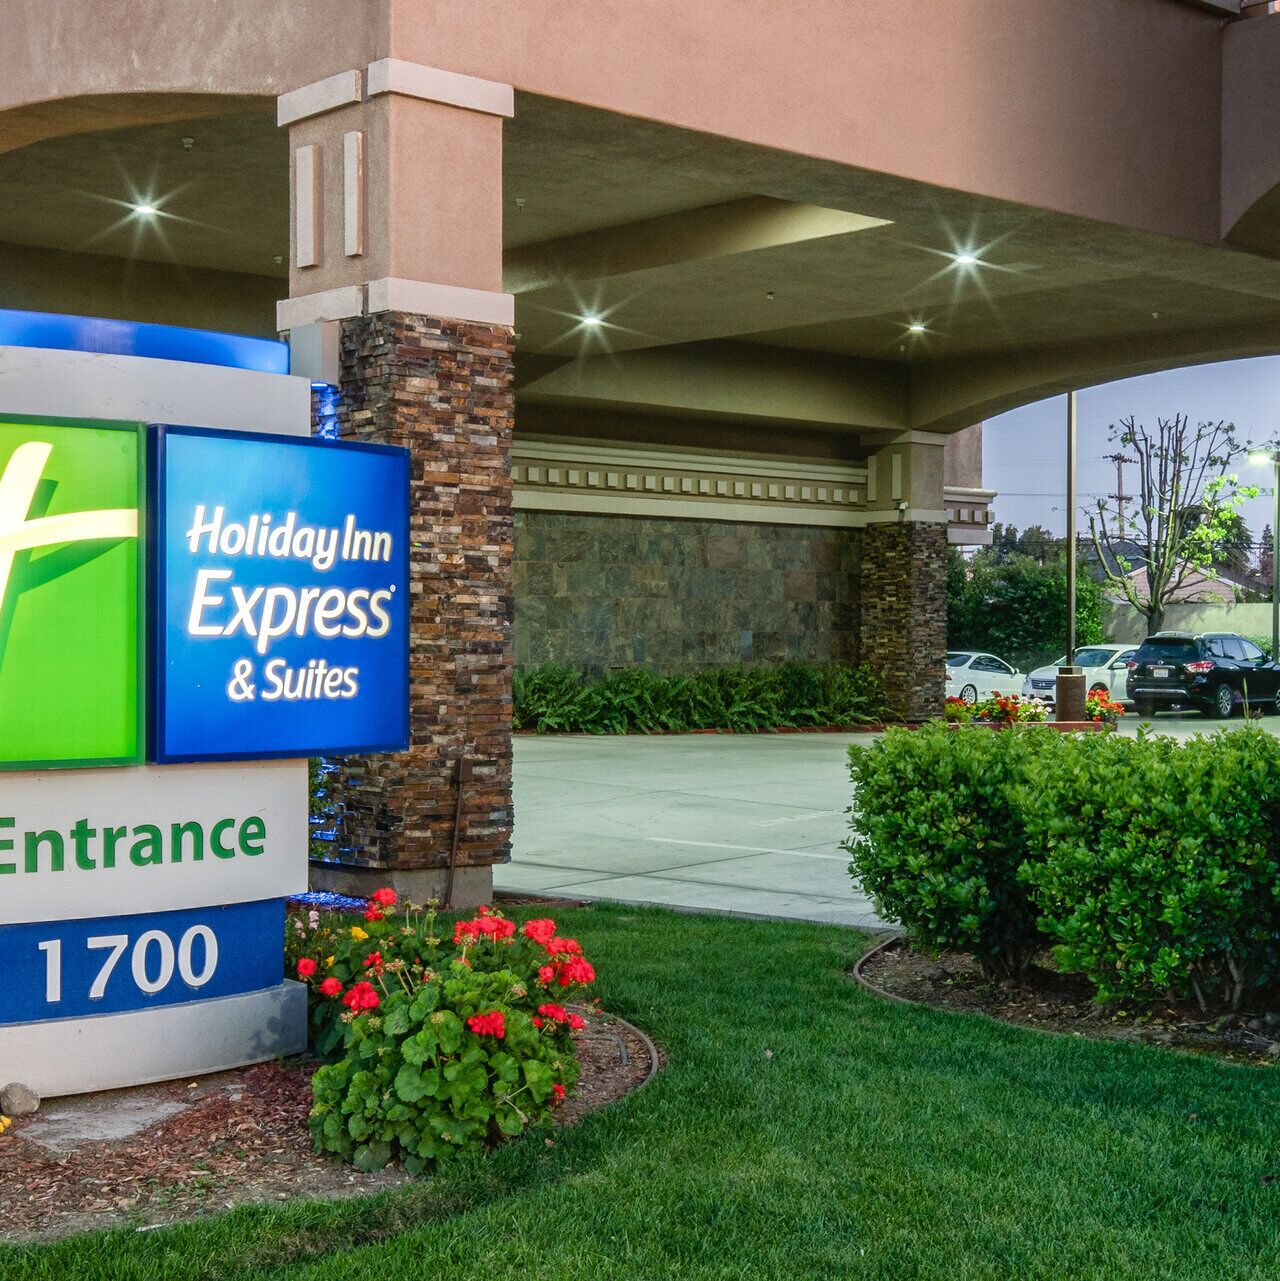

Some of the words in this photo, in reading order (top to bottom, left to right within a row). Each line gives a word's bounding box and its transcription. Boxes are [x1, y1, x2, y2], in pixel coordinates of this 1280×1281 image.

[186, 505, 339, 571] Holiday
[342, 514, 393, 562] Inn
[228, 659, 256, 700] &
[262, 659, 359, 699] Suites
[38, 924, 219, 1004] 1700
